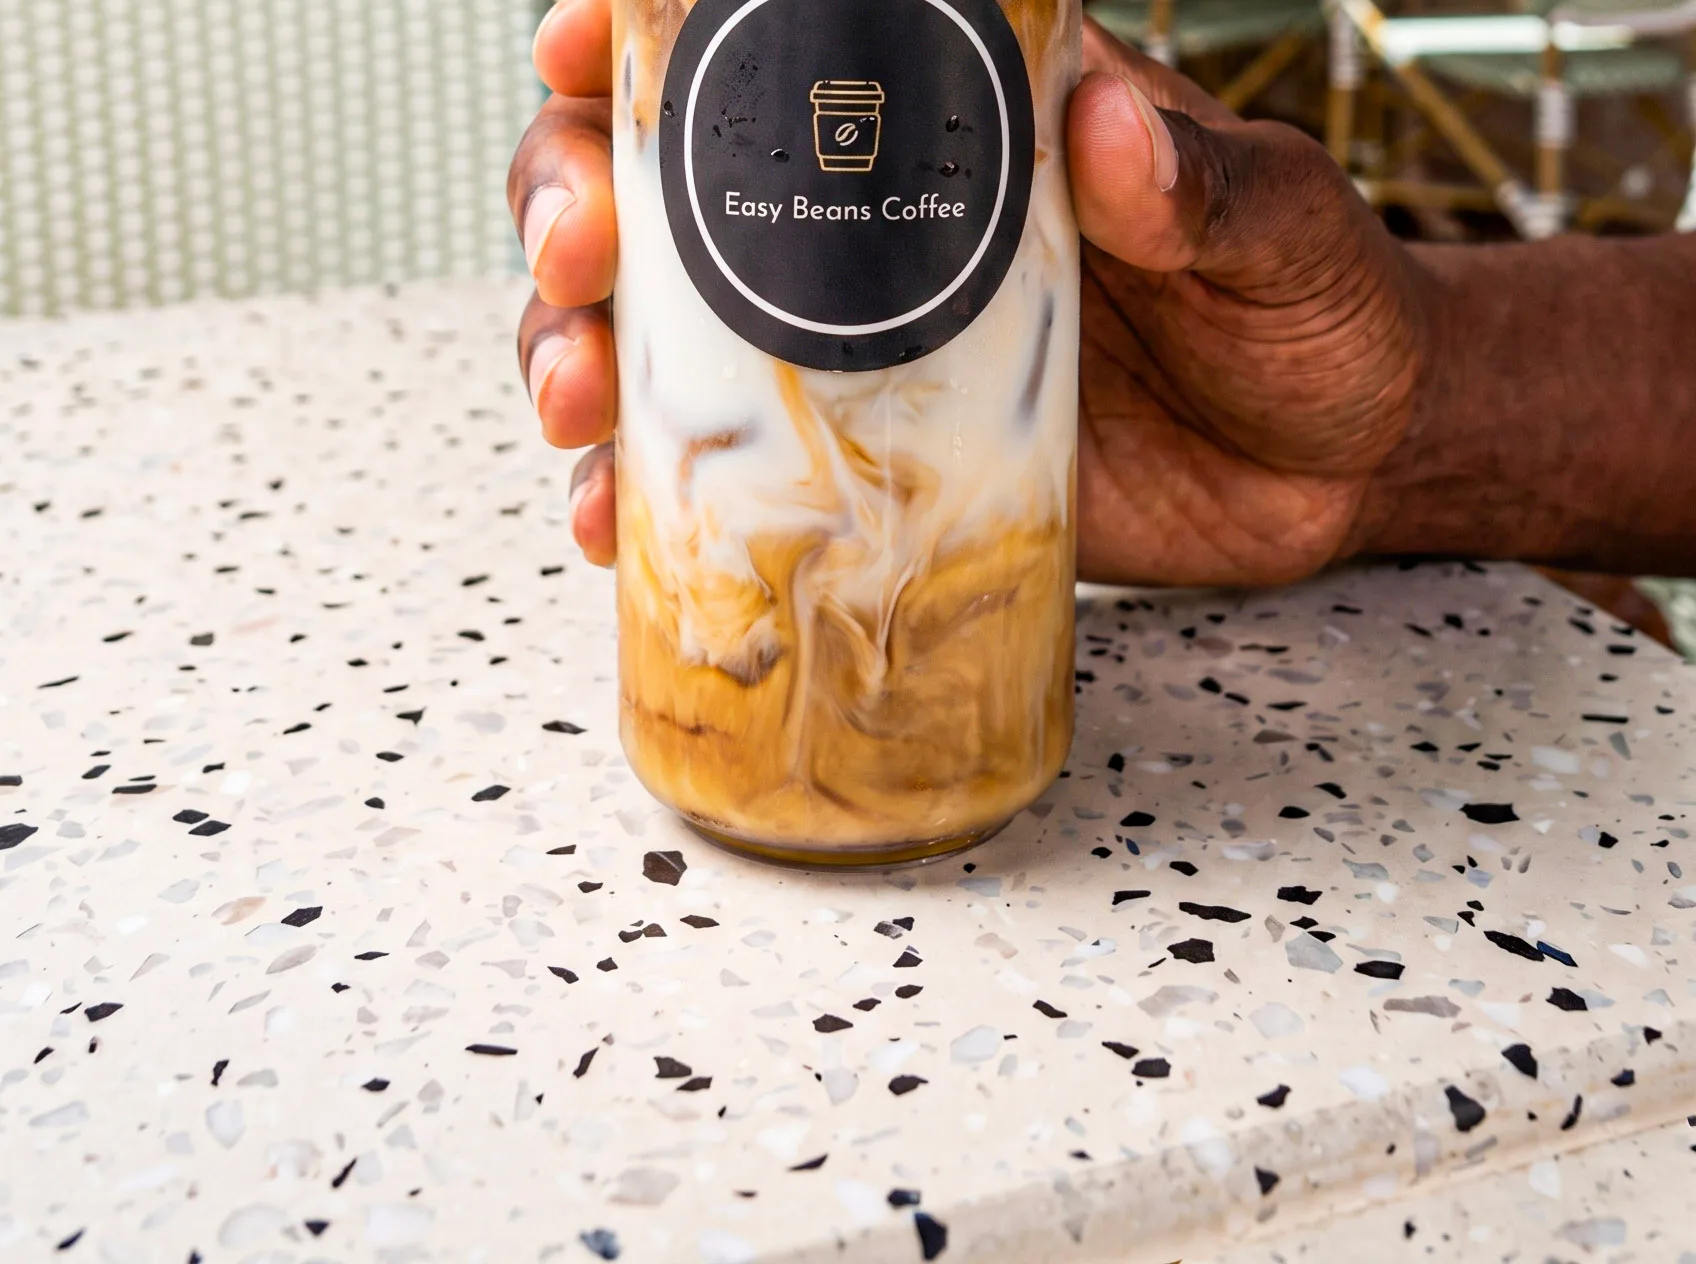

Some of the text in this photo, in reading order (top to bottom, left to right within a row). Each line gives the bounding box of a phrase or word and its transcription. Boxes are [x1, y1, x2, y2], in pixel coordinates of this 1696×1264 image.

[725, 191, 967, 224] Easy Beans Coffee
